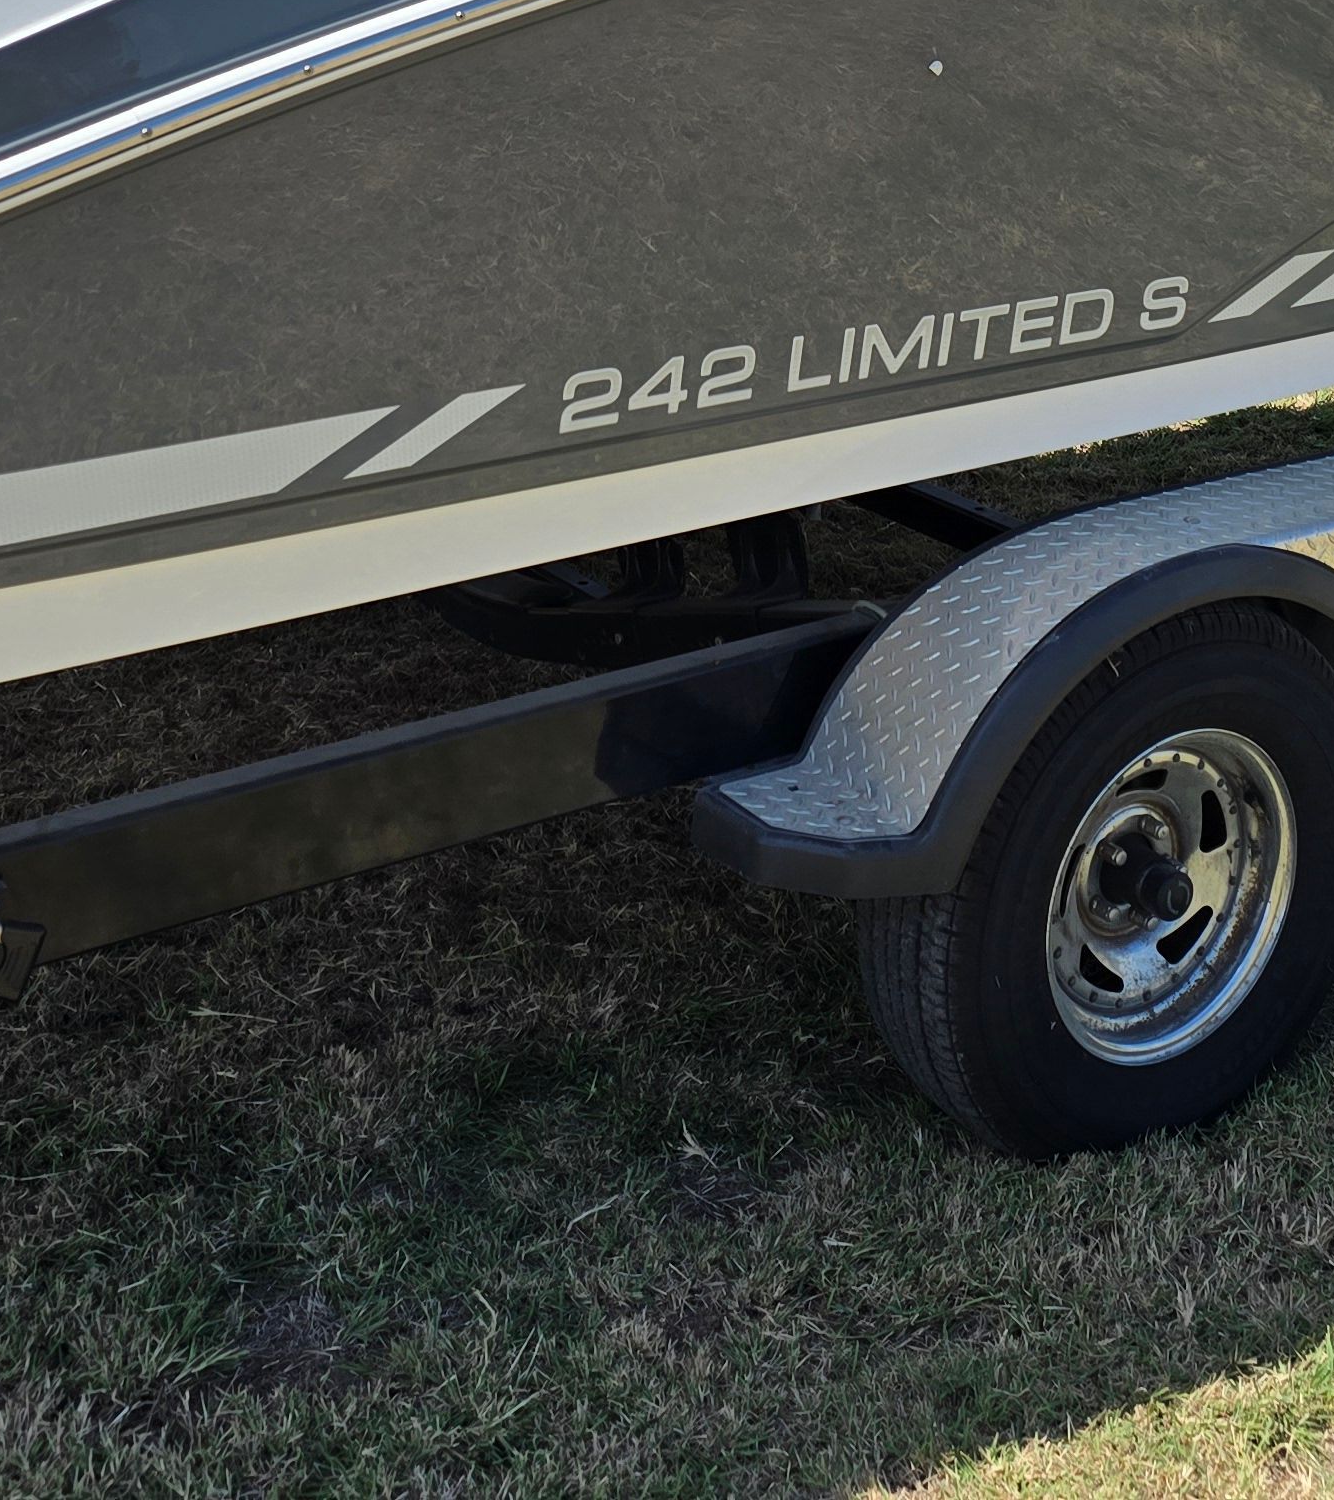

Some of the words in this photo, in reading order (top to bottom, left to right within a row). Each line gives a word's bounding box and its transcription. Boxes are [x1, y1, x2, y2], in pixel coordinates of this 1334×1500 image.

[559, 344, 757, 435] 242
[787, 288, 1115, 393] LIMITED
[1139, 275, 1189, 331] S
